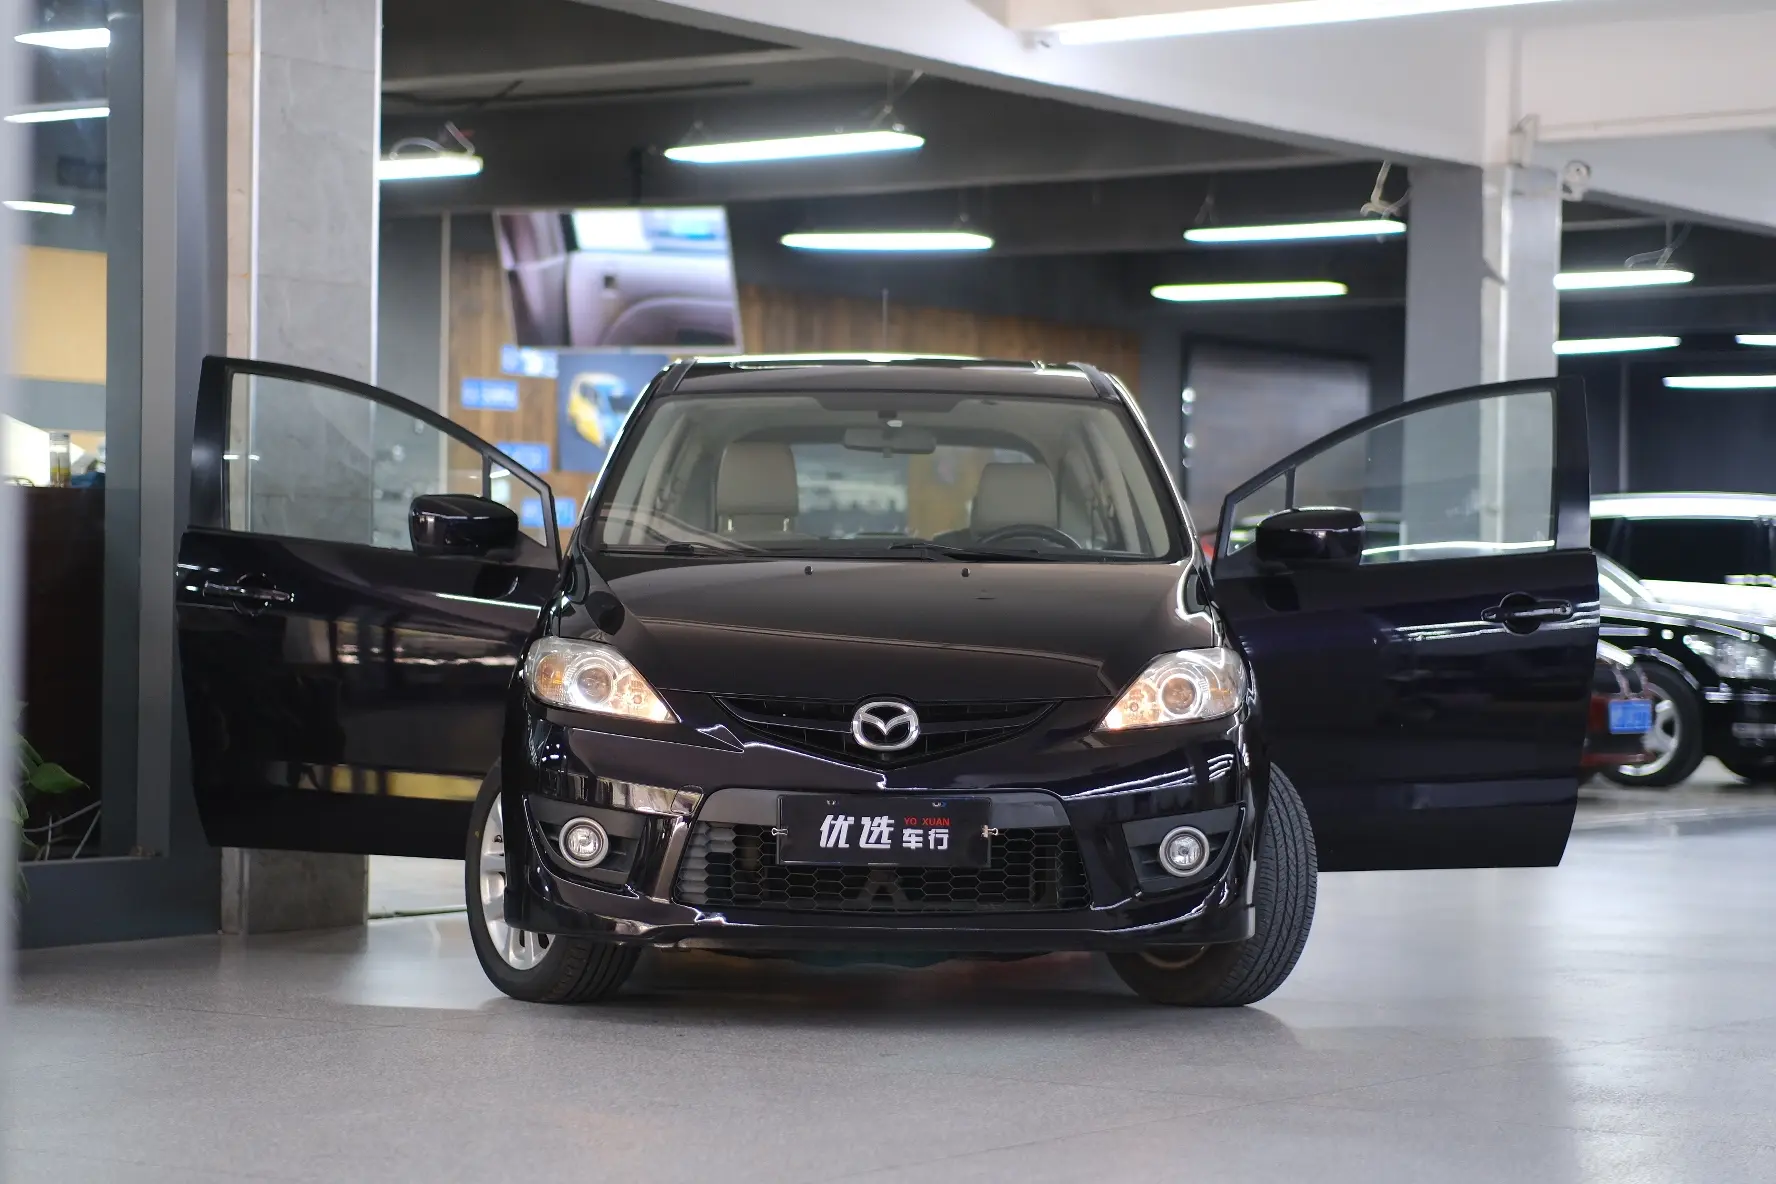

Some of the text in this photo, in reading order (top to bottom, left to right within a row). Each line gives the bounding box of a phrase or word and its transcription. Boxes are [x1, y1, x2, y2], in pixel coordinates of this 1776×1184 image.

[820, 815, 894, 848] 优选
[904, 817, 950, 826] YO XUAN
[902, 828, 949, 849] 车行
